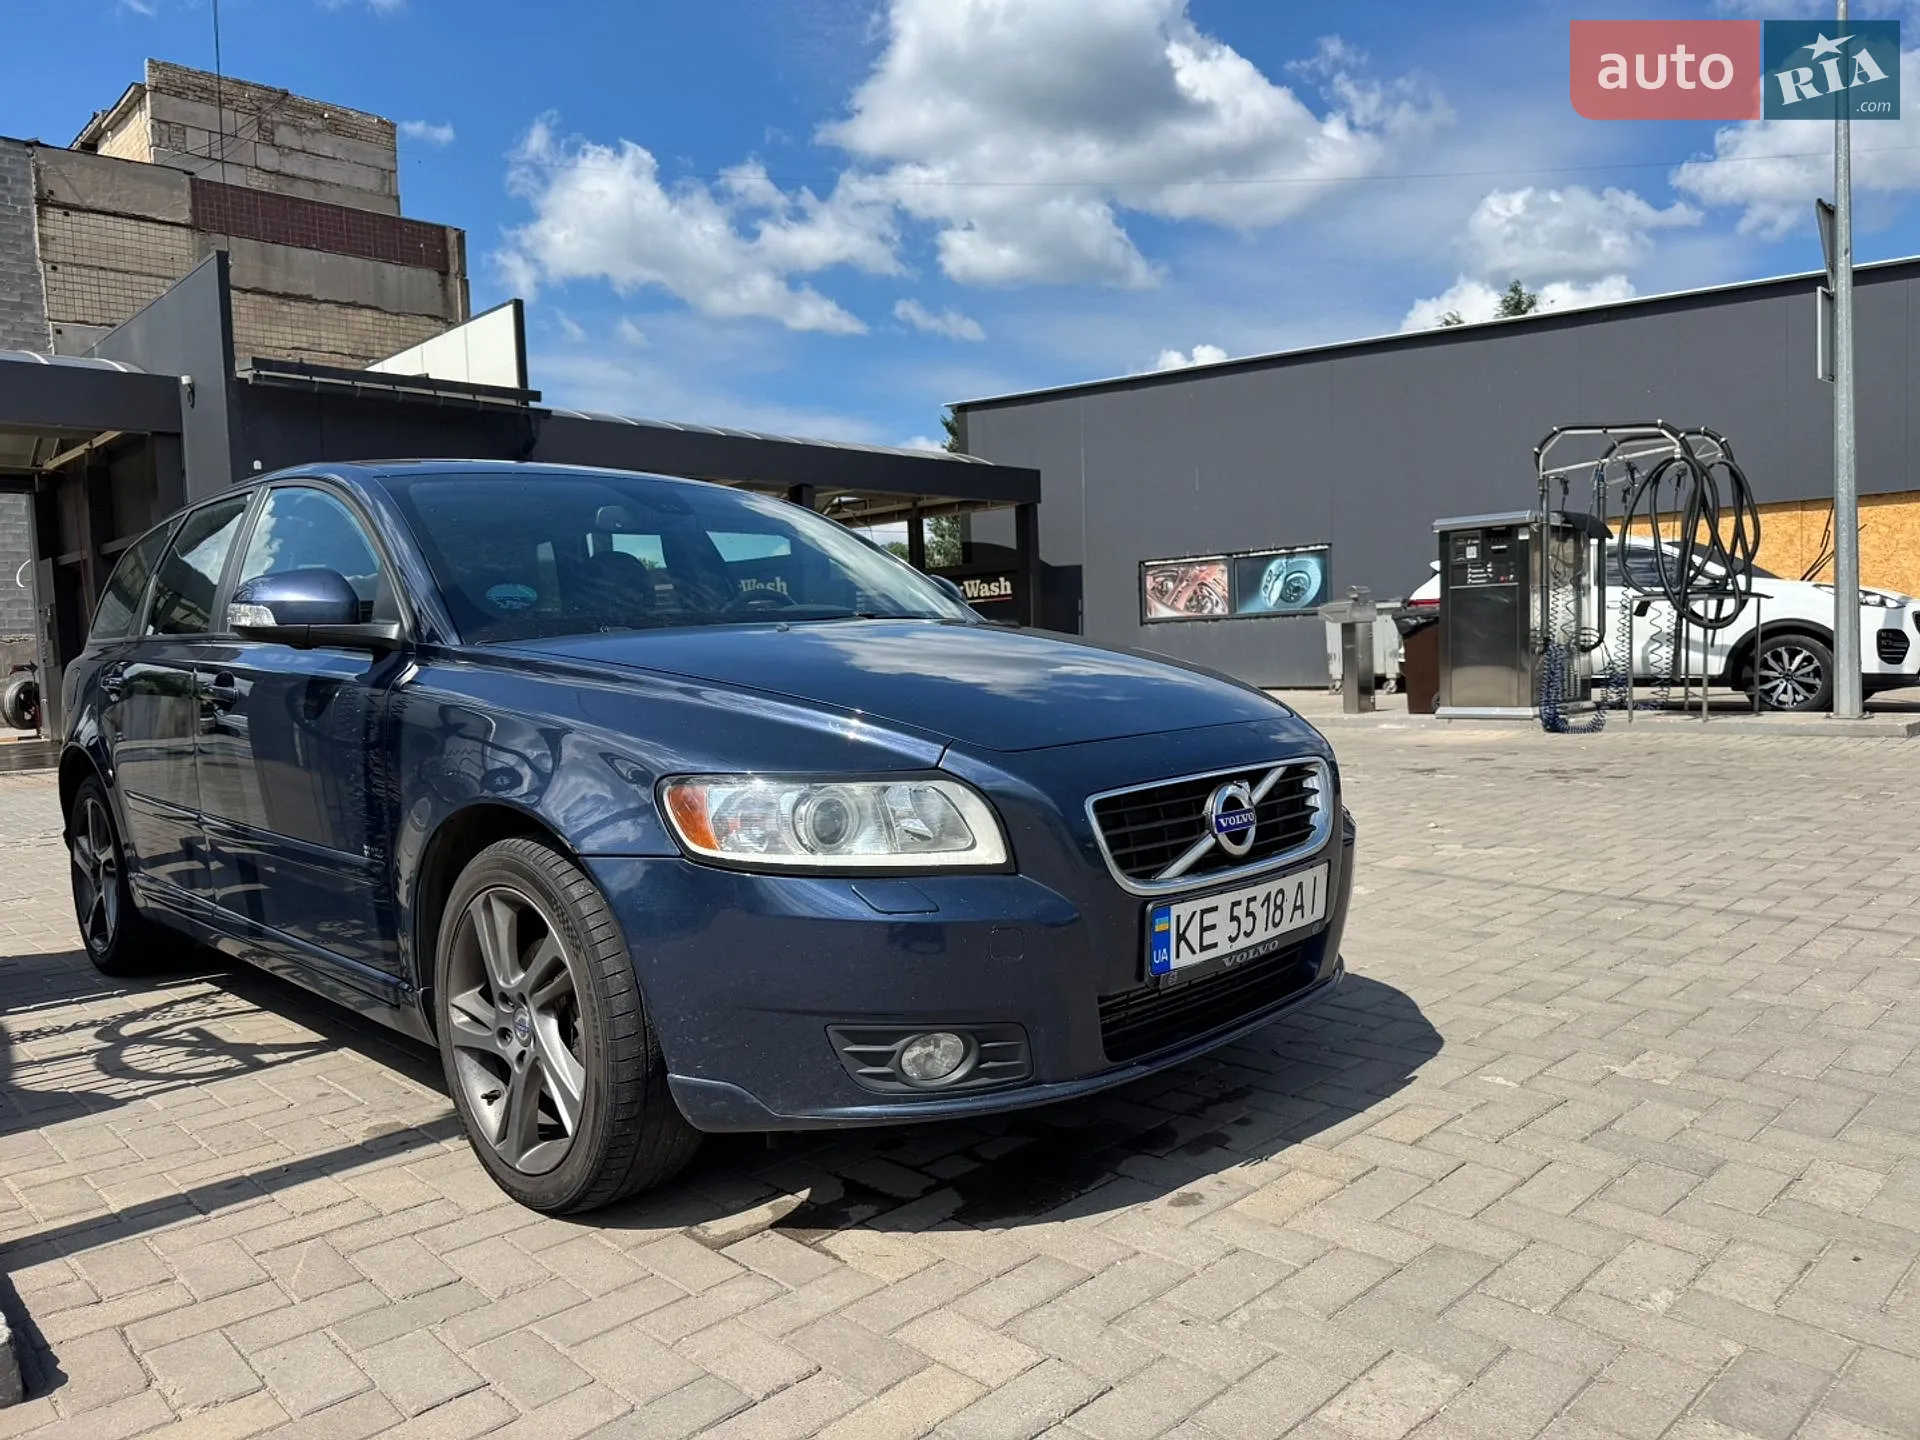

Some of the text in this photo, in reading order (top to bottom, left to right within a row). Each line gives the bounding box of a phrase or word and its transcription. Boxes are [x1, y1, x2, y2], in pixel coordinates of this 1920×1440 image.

[963, 576, 1013, 598] Wash
[1218, 812, 1255, 828] VOLVO
[1174, 875, 1318, 960] KE 5518 AI
[1153, 947, 1169, 964] UA
[1222, 939, 1280, 967] VOLVO
